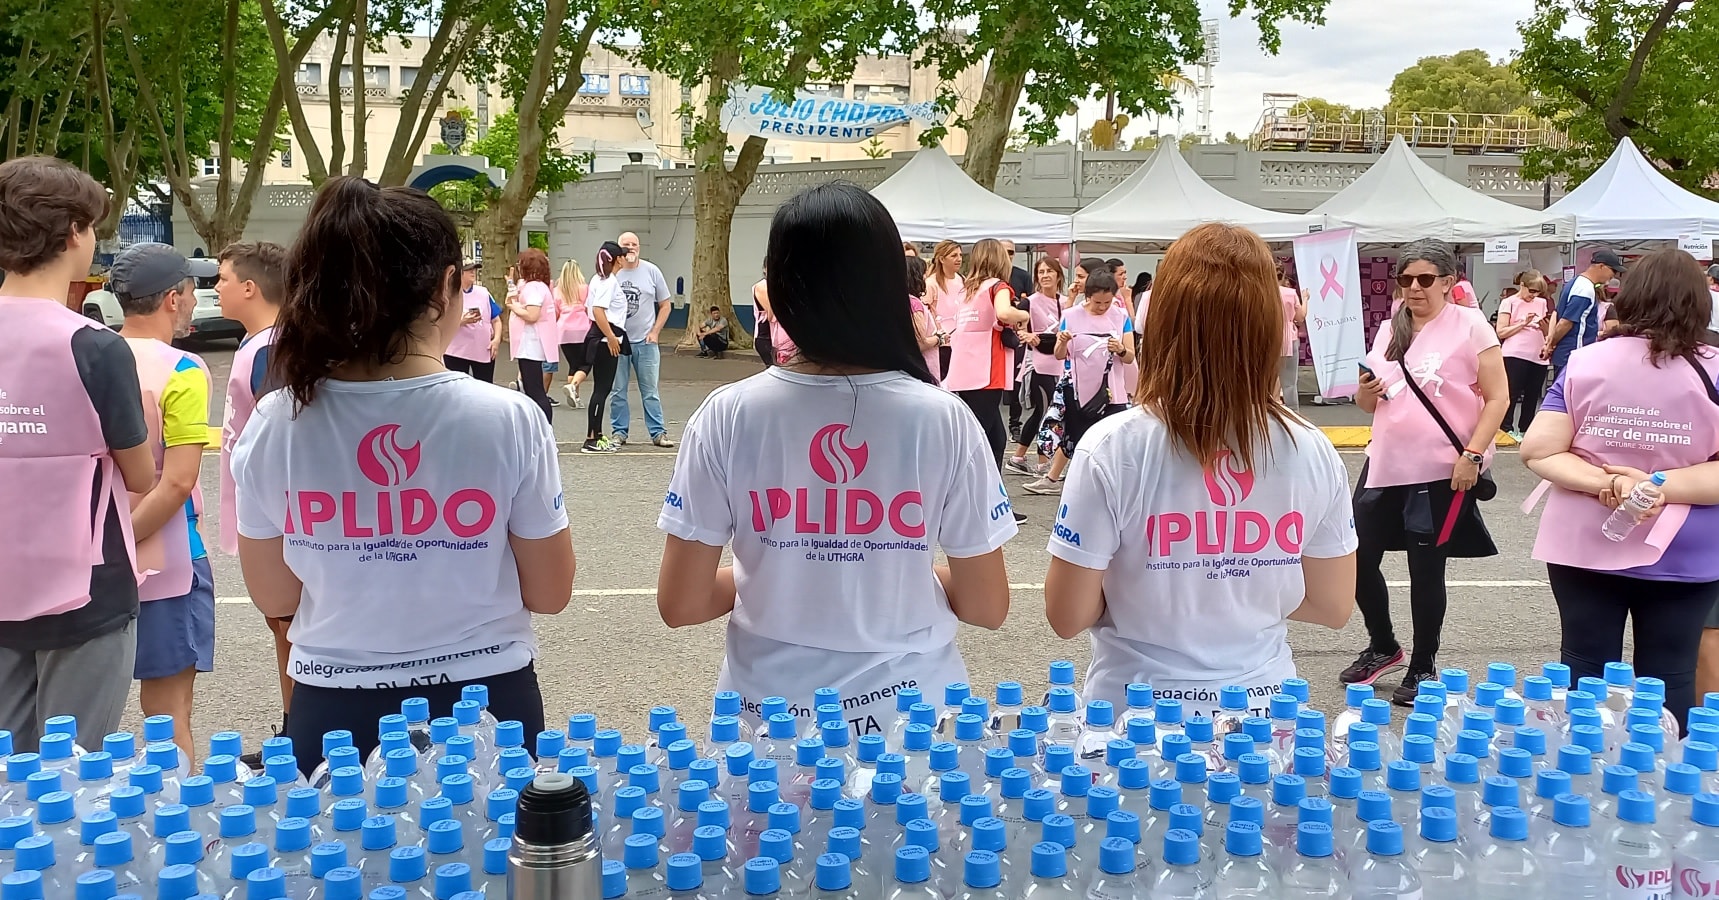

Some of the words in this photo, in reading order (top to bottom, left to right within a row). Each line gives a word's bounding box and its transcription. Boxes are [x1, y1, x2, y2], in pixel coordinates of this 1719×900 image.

[759, 120, 875, 138] PRESIDENTE
[32, 404, 46, 416] el
[1607, 404, 1645, 415] Jornada
[1647, 407, 1660, 416] de
[1583, 413, 1650, 428] ncientización
[1651, 419, 1681, 430] sobre
[1682, 422, 1692, 431] el
[1579, 423, 1620, 438] cáncer
[1622, 428, 1642, 441] de
[1645, 432, 1692, 445] mama
[1605, 440, 1637, 449] OCTUBRE
[1638, 443, 1655, 451] 2022
[284, 488, 496, 538] IPLIDO
[749, 487, 926, 538] IPLIDO
[327, 542, 350, 552] para
[352, 540, 361, 551] la
[400, 539, 413, 549] de
[415, 539, 489, 551] Oportunidades
[779, 540, 799, 550] para
[801, 538, 809, 547] la
[811, 539, 849, 550] Igualdad
[850, 540, 862, 548] de
[358, 553, 372, 563] de
[374, 552, 383, 560] la
[805, 551, 817, 561] de
[818, 551, 825, 561] la
[828, 552, 865, 562] UTHGRA
[1182, 561, 1200, 571] para
[1202, 558, 1210, 567] la
[1238, 558, 1249, 566] de
[1206, 570, 1218, 579] de
